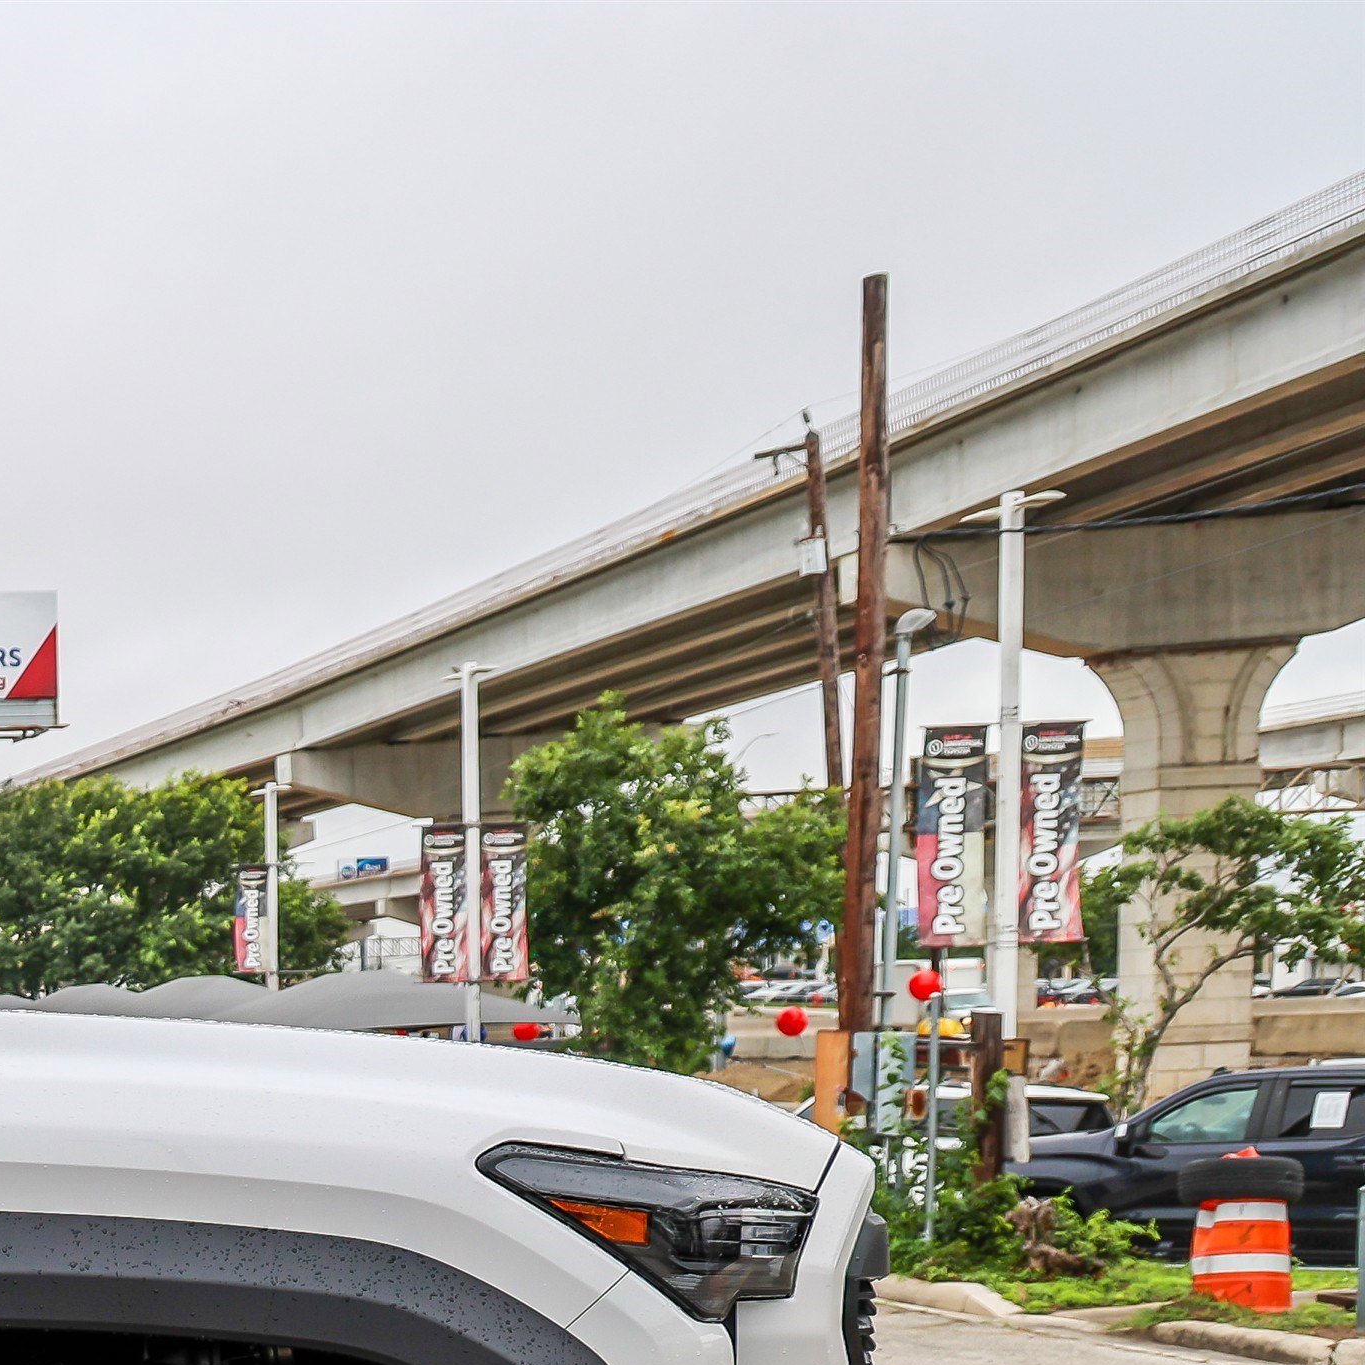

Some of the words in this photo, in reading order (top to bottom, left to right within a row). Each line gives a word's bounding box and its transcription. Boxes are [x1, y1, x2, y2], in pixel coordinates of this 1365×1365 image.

[931, 777, 967, 881] Owned
[1027, 773, 1061, 877] Owned
[242, 889, 259, 940] Owned
[432, 861, 454, 934] Owned
[490, 859, 513, 933] Owned
[932, 885, 966, 935] Pre
[1028, 880, 1061, 930] Pre
[244, 942, 261, 969] Pre
[434, 938, 455, 974] Pre
[493, 936, 514, 973] Pre
